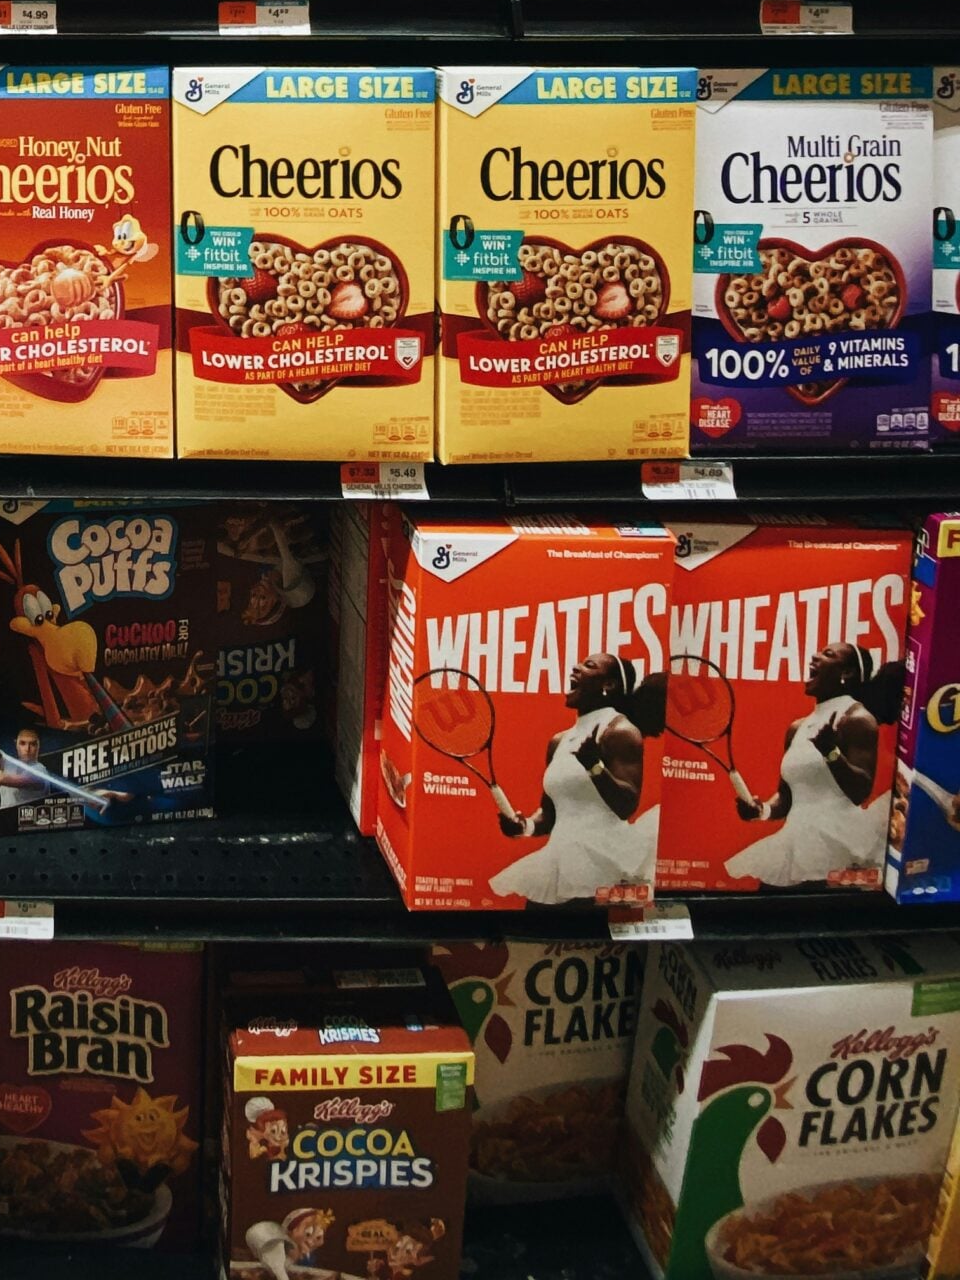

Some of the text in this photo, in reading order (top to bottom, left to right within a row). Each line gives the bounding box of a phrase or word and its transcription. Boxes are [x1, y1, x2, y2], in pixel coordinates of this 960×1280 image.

[6, 72, 146, 94] LARGE SIZE
[787, 135, 901, 158] Multi Grain
[213, 237, 235, 246] WIN
[204, 248, 240, 262] fitbit
[473, 251, 510, 266] fitbit
[717, 246, 753, 260] fitbit
[11, 324, 81, 344] can help
[273, 334, 344, 352] CAN HELP
[793, 346, 820, 356] DAILY
[828, 338, 905, 355] 9 VITAMINS
[705, 348, 789, 380] 100%
[792, 355, 821, 365] VALUE
[823, 354, 908, 371] & MINERALS
[547, 550, 659, 560] The Breakfast of Champions
[112, 718, 176, 746] INTERACTIVE
[113, 729, 177, 766] TATTOOS
[63, 739, 108, 777] FREE
[662, 756, 708, 770] Serena
[161, 774, 205, 789] WARS
[423, 772, 469, 785] Serena
[662, 767, 715, 782] Williams
[424, 783, 477, 797] Williams
[13, 987, 167, 1045] Raisin
[31, 1031, 152, 1081] Bran
[254, 1066, 417, 1087] FAMILY SIZE
[807, 1050, 947, 1106] CORN
[800, 1095, 939, 1147] FLAKES
[293, 1130, 414, 1159] COCOA
[270, 1158, 433, 1192] KRISPIES
